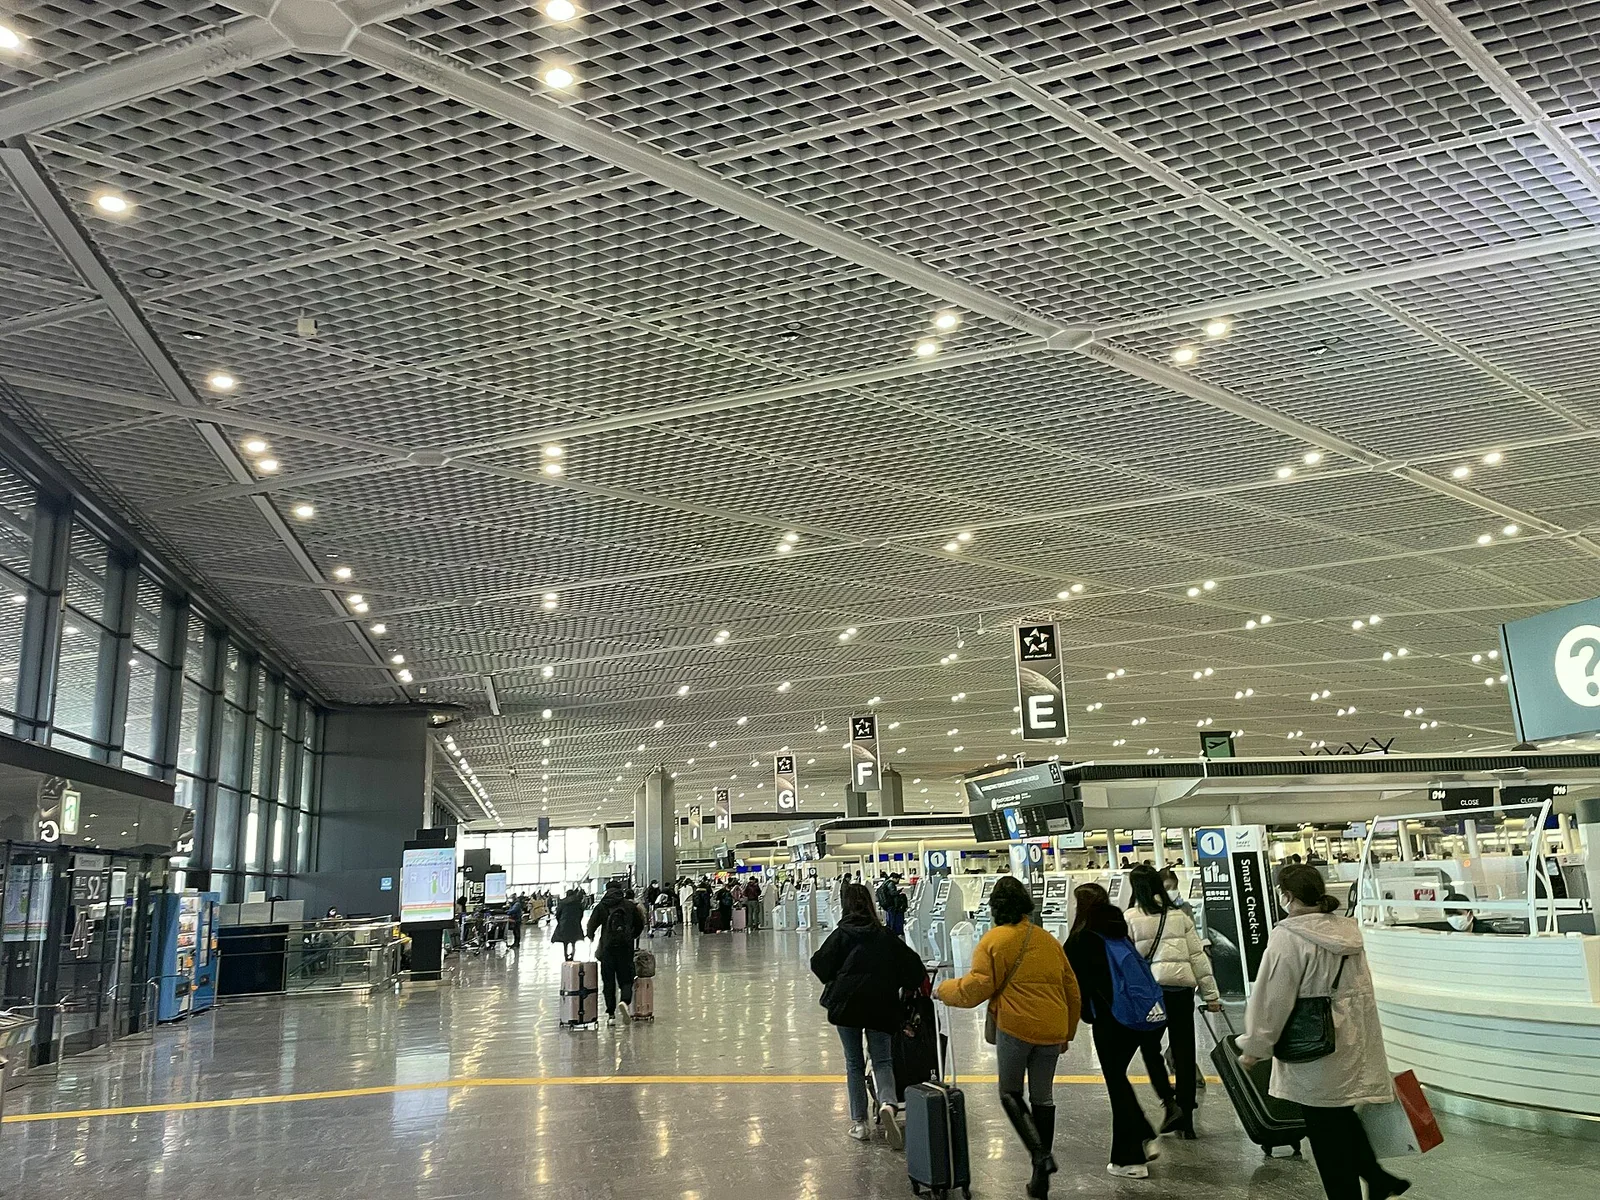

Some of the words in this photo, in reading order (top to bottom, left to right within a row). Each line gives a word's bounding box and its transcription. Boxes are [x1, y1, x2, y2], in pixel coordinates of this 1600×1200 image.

[1028, 694, 1057, 729] E
[857, 761, 874, 785] F
[778, 790, 795, 809] G
[717, 814, 729, 830] H
[1207, 836, 1215, 851] 1
[1241, 859, 1254, 893] Smart
[1246, 896, 1261, 945] Check-in
[1145, 1011, 1167, 1022] adidas
